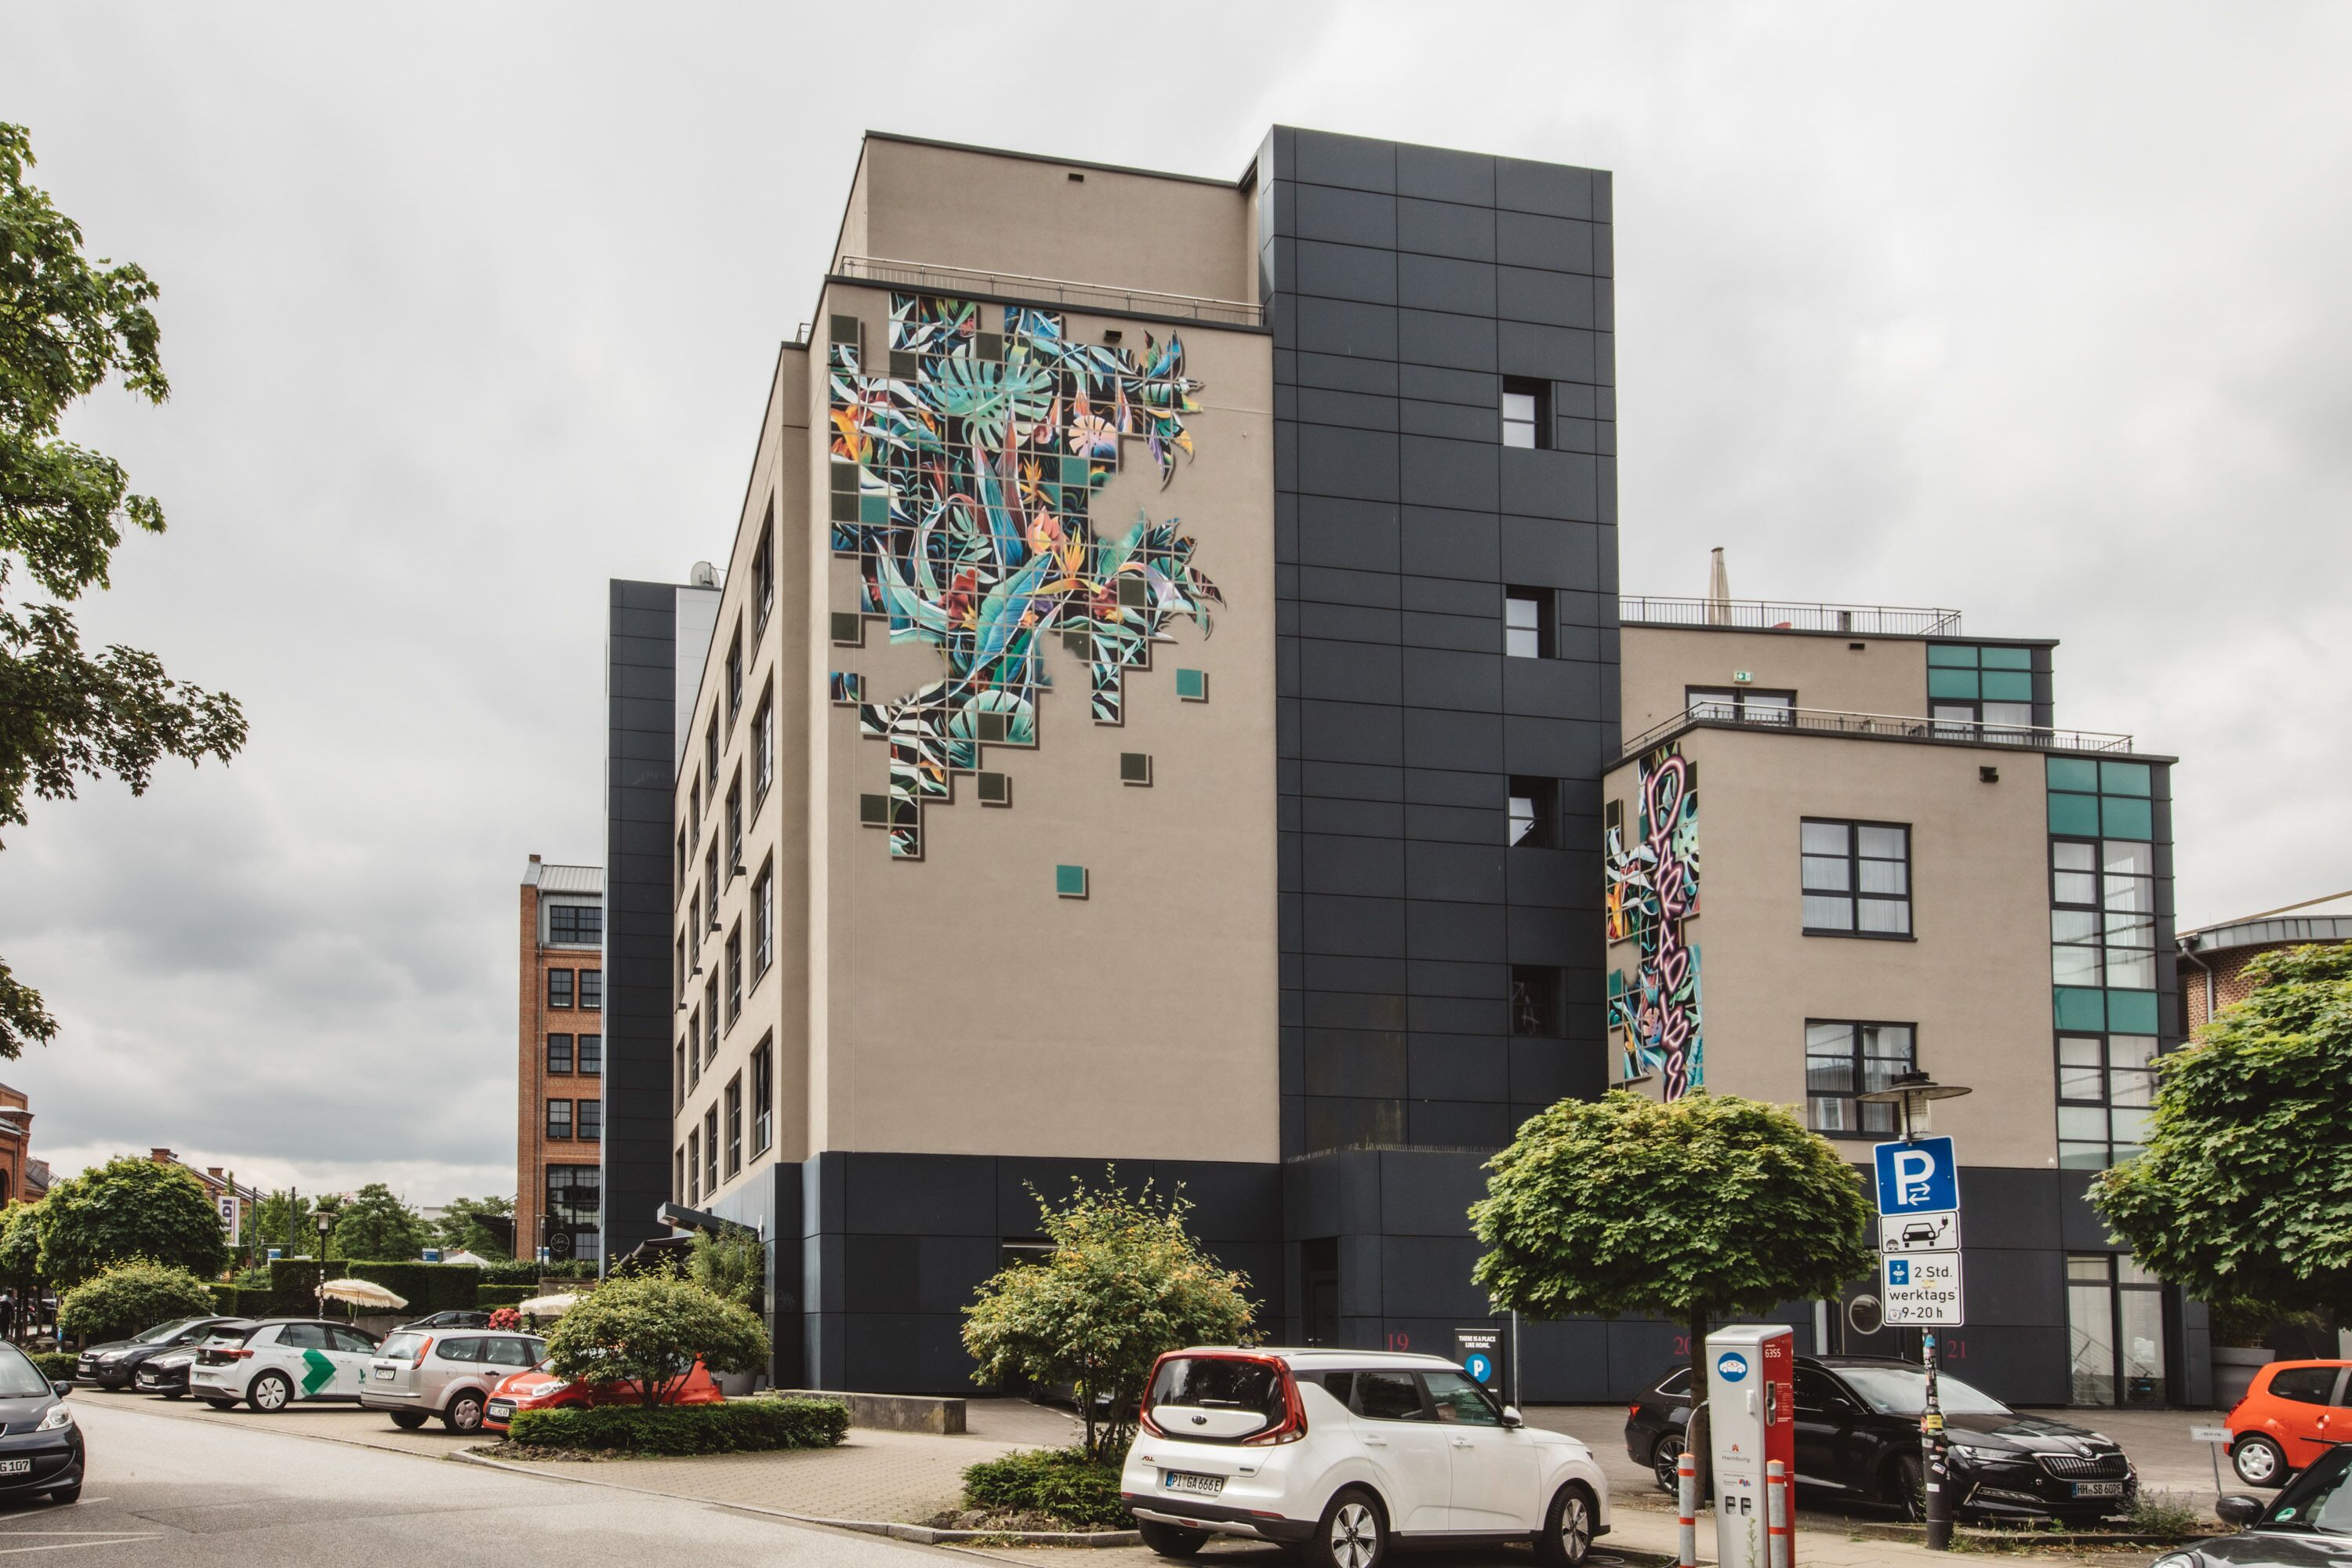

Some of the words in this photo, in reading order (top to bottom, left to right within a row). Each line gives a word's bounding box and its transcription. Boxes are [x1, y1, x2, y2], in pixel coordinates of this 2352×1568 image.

[1893, 1150, 1935, 1205] P
[1915, 1267, 1922, 1277] 2
[1926, 1266, 1952, 1278] Std.
[1889, 1290, 1955, 1303] werktags
[1902, 1307, 1933, 1318] 9-20
[1936, 1307, 1943, 1318] h
[1388, 1334, 1409, 1352] 19
[1947, 1340, 1966, 1358] 21
[1765, 1348, 1780, 1357] 6355
[1474, 1360, 1483, 1377] P
[9, 1461, 29, 1472] 107
[1172, 1475, 1181, 1487] PI
[1186, 1478, 1197, 1490] GA
[2077, 1484, 2088, 1494] HH
[2093, 1484, 2103, 1494] SB
